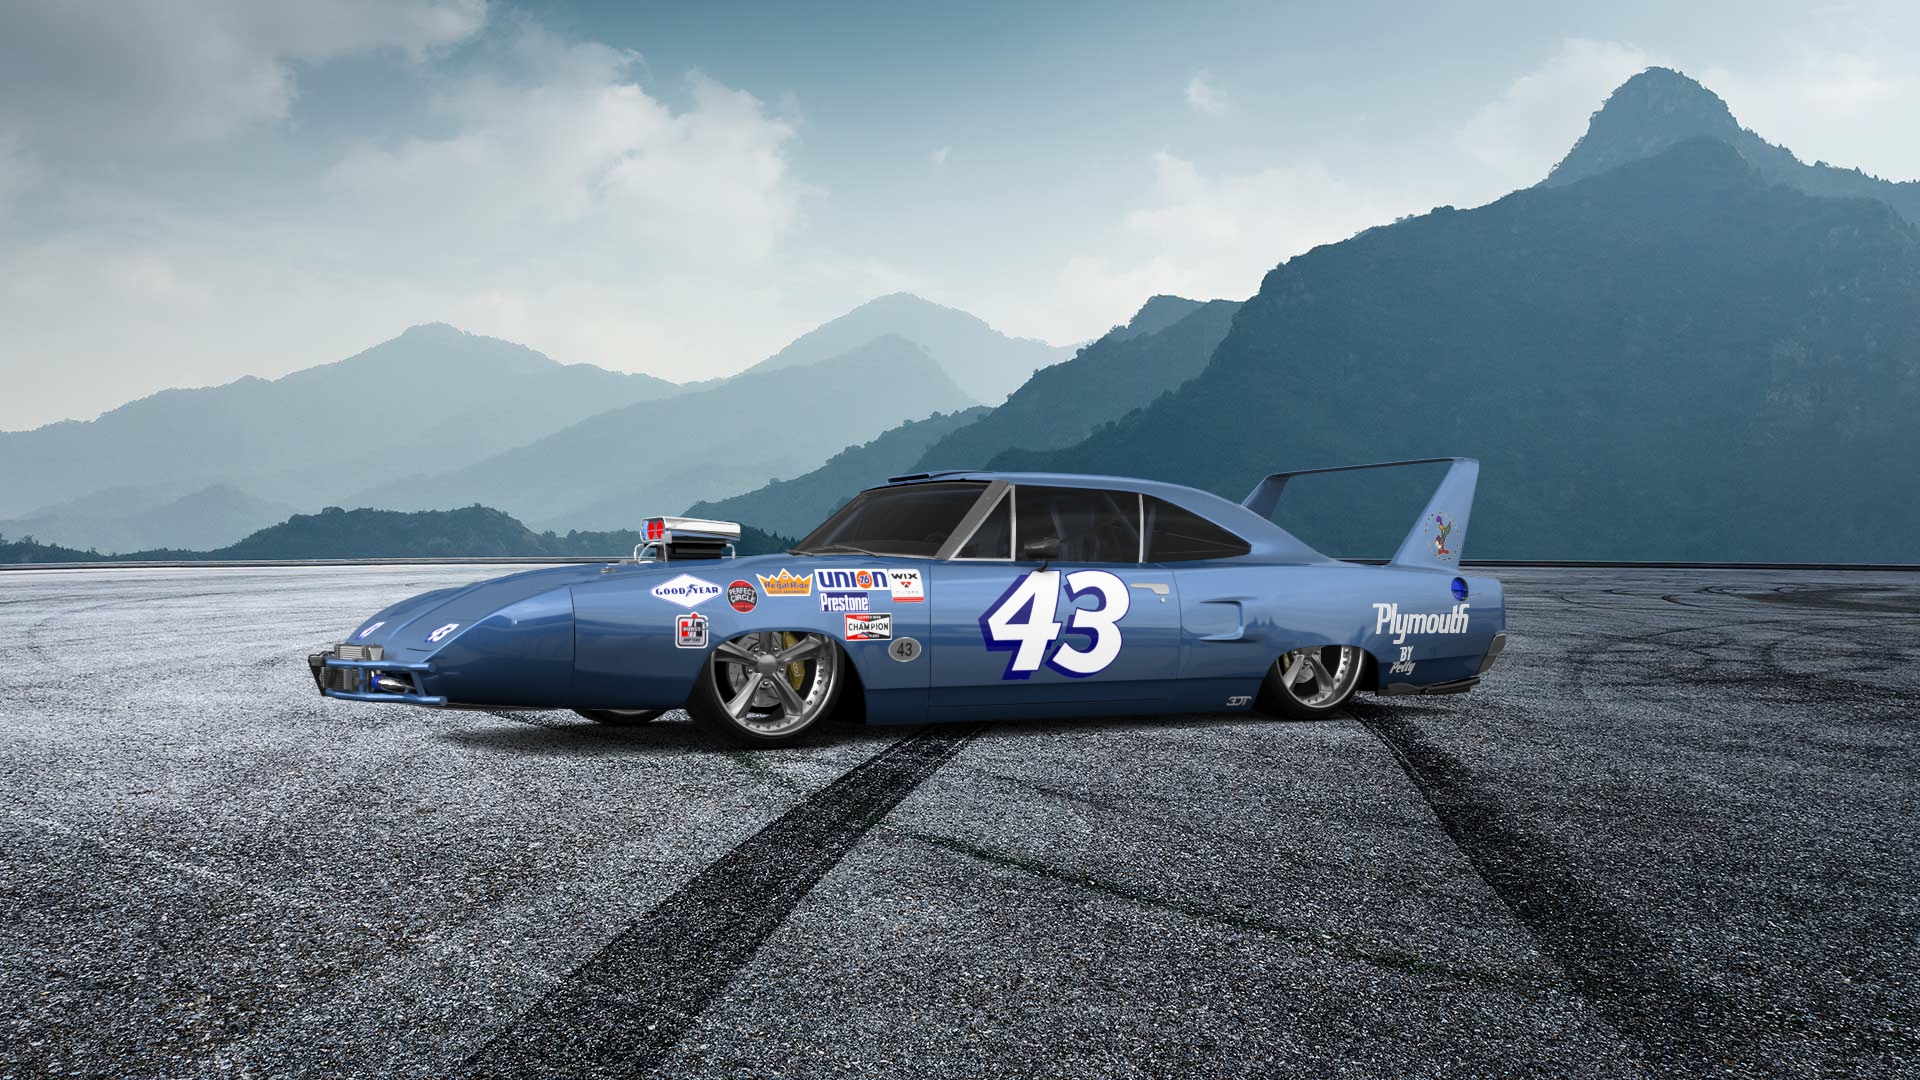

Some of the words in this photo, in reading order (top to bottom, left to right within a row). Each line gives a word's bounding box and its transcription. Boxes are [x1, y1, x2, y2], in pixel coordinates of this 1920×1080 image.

[764, 581, 789, 590] Regal
[860, 575, 870, 584] 76
[655, 584, 719, 597] GOODYEAR
[729, 587, 756, 598] PERFECT
[730, 594, 756, 604] CIRCLE
[820, 593, 869, 612] Prestone
[848, 622, 889, 631] CHAMPION
[978, 569, 1131, 680] 43
[1373, 603, 1470, 645] Plymouth
[896, 642, 913, 657] 43
[1400, 646, 1414, 662] BY
[1389, 661, 1416, 676] Petty
